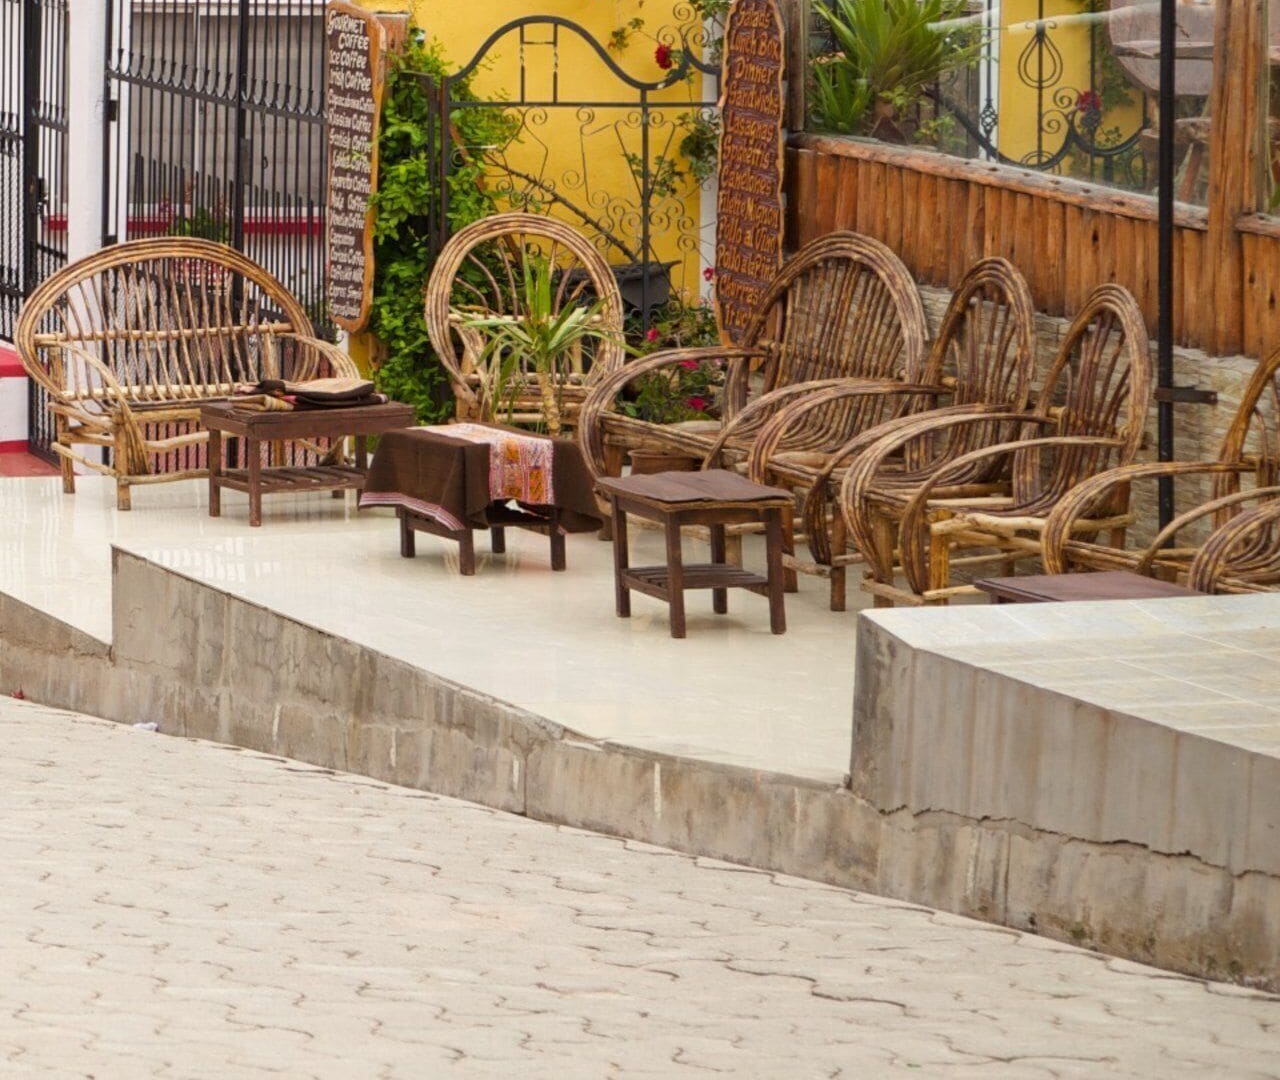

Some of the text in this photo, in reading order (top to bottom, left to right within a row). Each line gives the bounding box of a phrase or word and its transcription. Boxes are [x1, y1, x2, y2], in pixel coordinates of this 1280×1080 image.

[736, 1, 770, 29] Salads
[729, 29, 780, 59] Lunch Box
[340, 50, 367, 69] Coffee
[734, 56, 774, 84] Dinner
[345, 71, 372, 92] Coffee
[717, 243, 742, 272] Pollo
